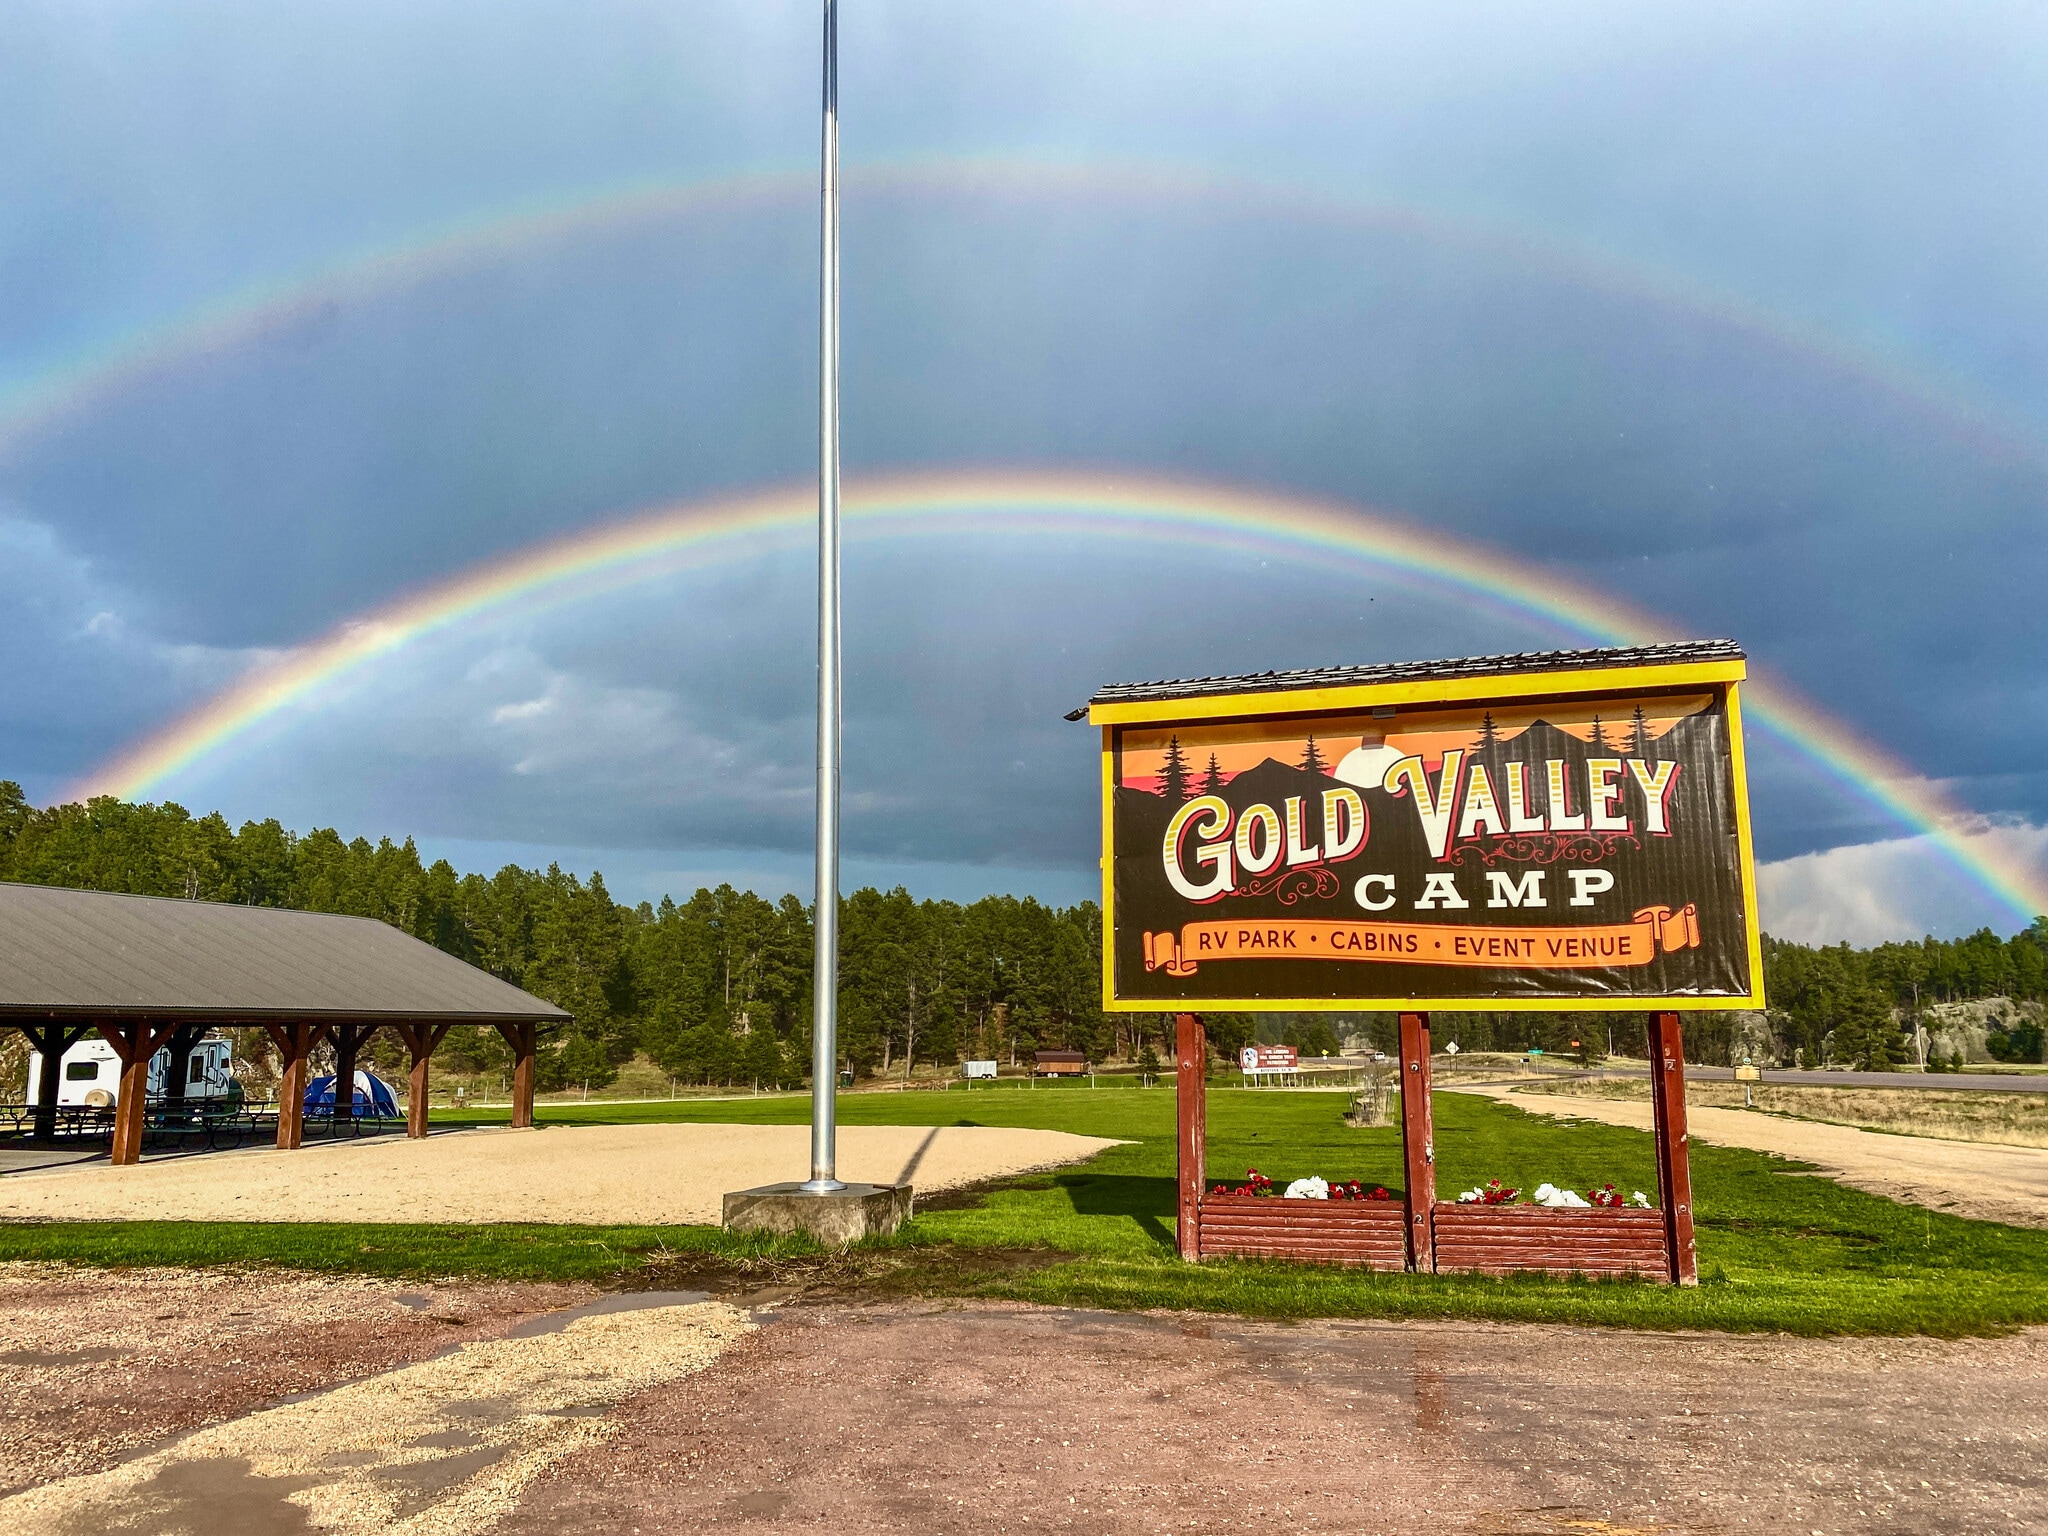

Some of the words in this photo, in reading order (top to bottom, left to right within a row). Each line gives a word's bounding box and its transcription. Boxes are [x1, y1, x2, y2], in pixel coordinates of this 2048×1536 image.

[1162, 787, 1369, 902] GOLD
[1383, 750, 1680, 861] VALLEY
[1354, 869, 1615, 911] CAMP
[1199, 931, 1228, 950] RV
[1238, 930, 1297, 949] PARK
[1330, 931, 1418, 953] CABINS
[1454, 936, 1536, 957] EVENT
[1546, 936, 1632, 957] VENUE
